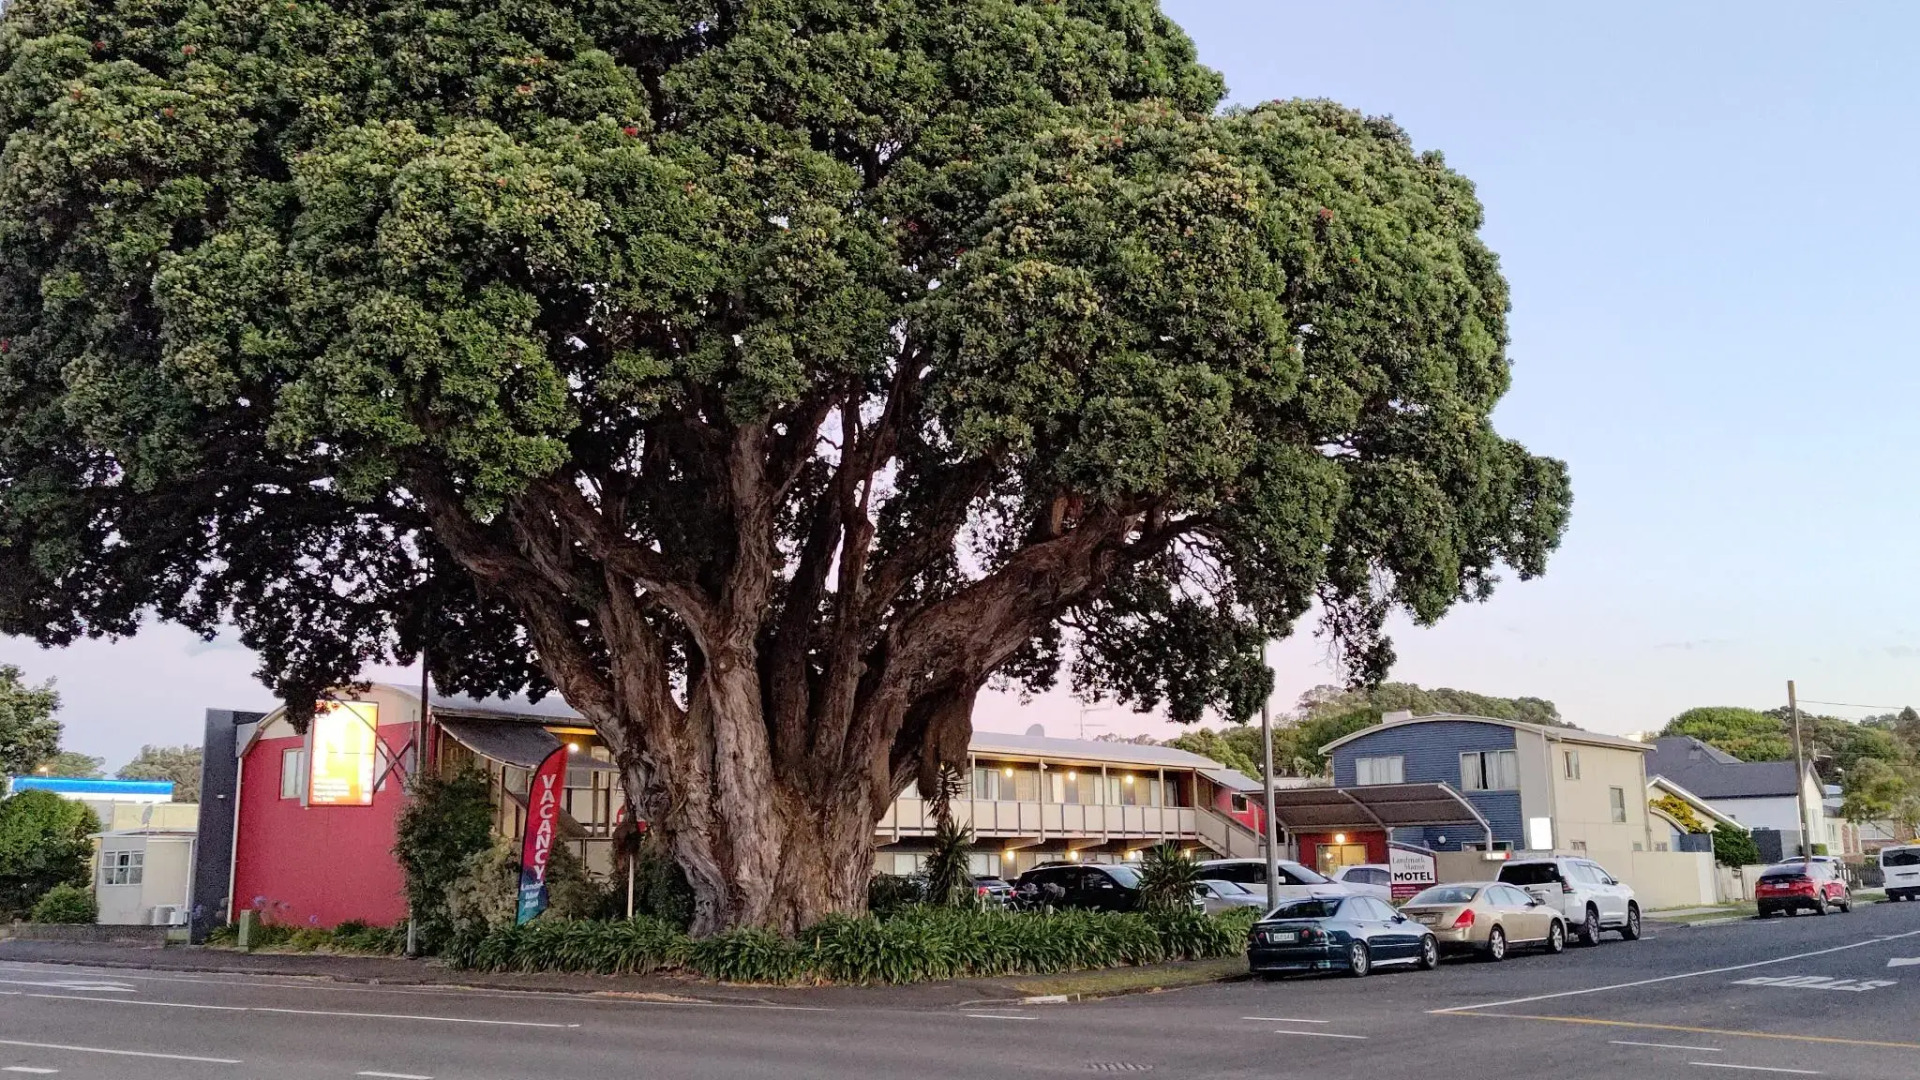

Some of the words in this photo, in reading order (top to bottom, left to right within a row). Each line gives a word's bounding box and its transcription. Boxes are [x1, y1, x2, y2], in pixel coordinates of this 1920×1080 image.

[533, 774, 556, 880] VACANCY
[1392, 856, 1426, 864] Landmark
[1393, 871, 1434, 881] MOTEL
